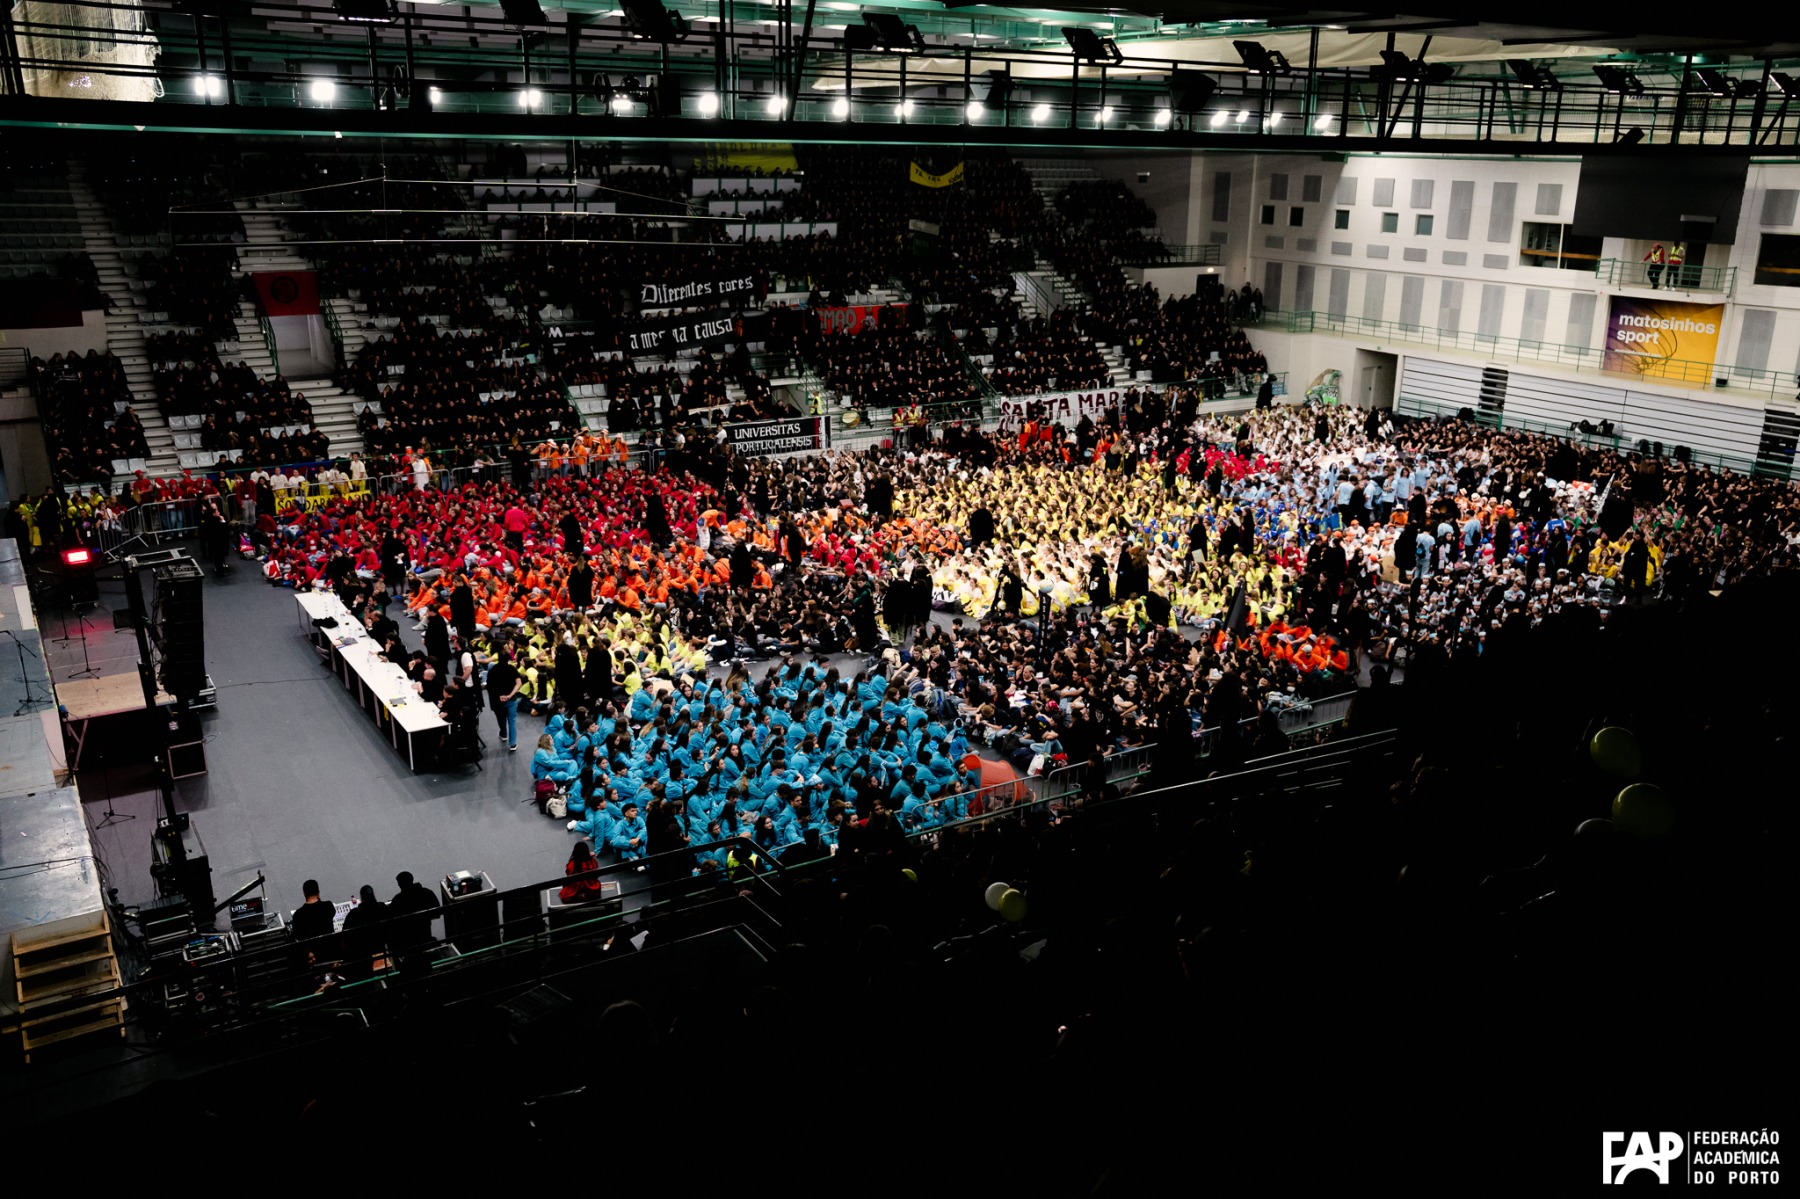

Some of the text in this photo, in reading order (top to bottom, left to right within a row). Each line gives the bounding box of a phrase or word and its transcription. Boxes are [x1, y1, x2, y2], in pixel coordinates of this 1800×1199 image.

[640, 276, 753, 304] Diferentes cores
[694, 318, 733, 340] causa
[1618, 314, 1716, 335] matosinhos
[1616, 329, 1660, 345] sport
[734, 423, 801, 440] UNIVERSITAS
[735, 437, 812, 454] PORTUCALENSIS
